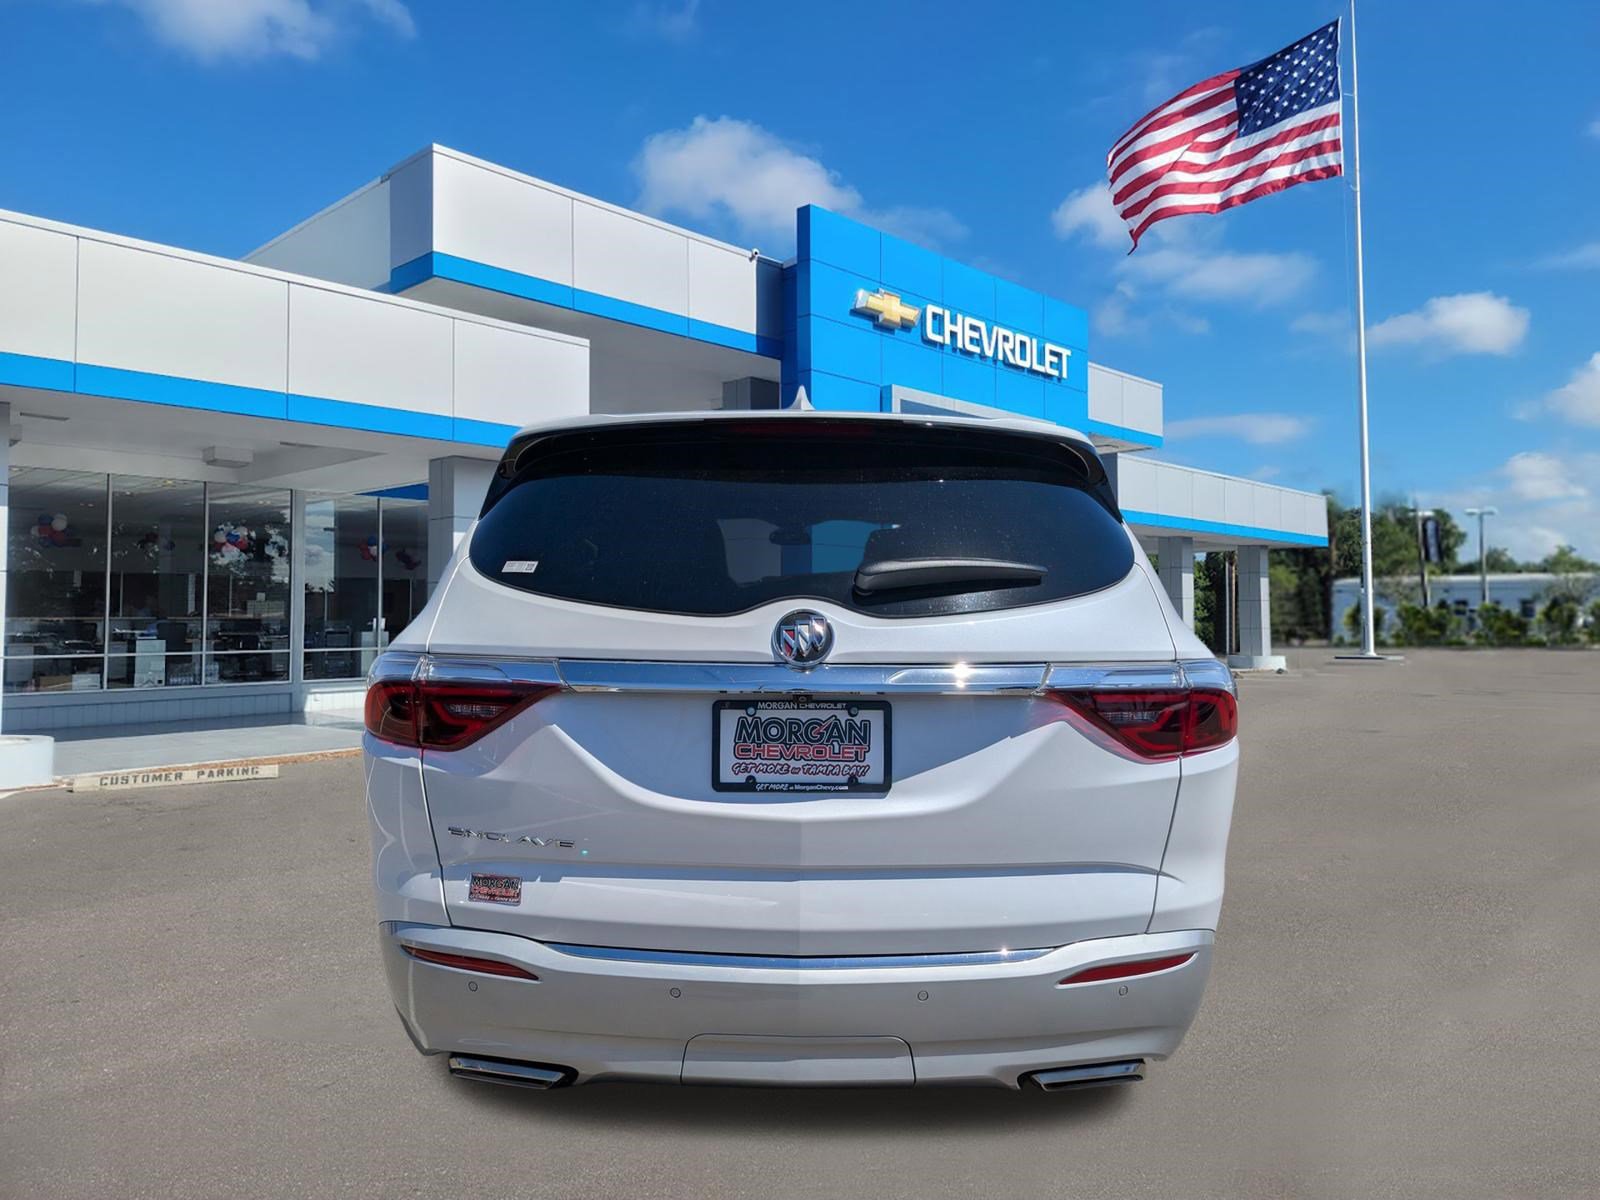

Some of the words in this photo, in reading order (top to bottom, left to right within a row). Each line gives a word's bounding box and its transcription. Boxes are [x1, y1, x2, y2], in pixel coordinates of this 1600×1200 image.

[925, 304, 1072, 379] CHEVROLET
[757, 702, 798, 710] MORGAN
[734, 715, 871, 745] MORGAN
[734, 743, 870, 762] CHEVROLET
[100, 771, 183, 786] CUSTOMER
[197, 766, 259, 779] PARKING
[732, 763, 756, 775] GET
[755, 763, 790, 776] MORE
[802, 763, 840, 777] TAMPA
[841, 764, 871, 778] BAY!
[755, 783, 770, 791] GET
[768, 783, 789, 791] MORE
[447, 825, 577, 849] ENCLAVE
